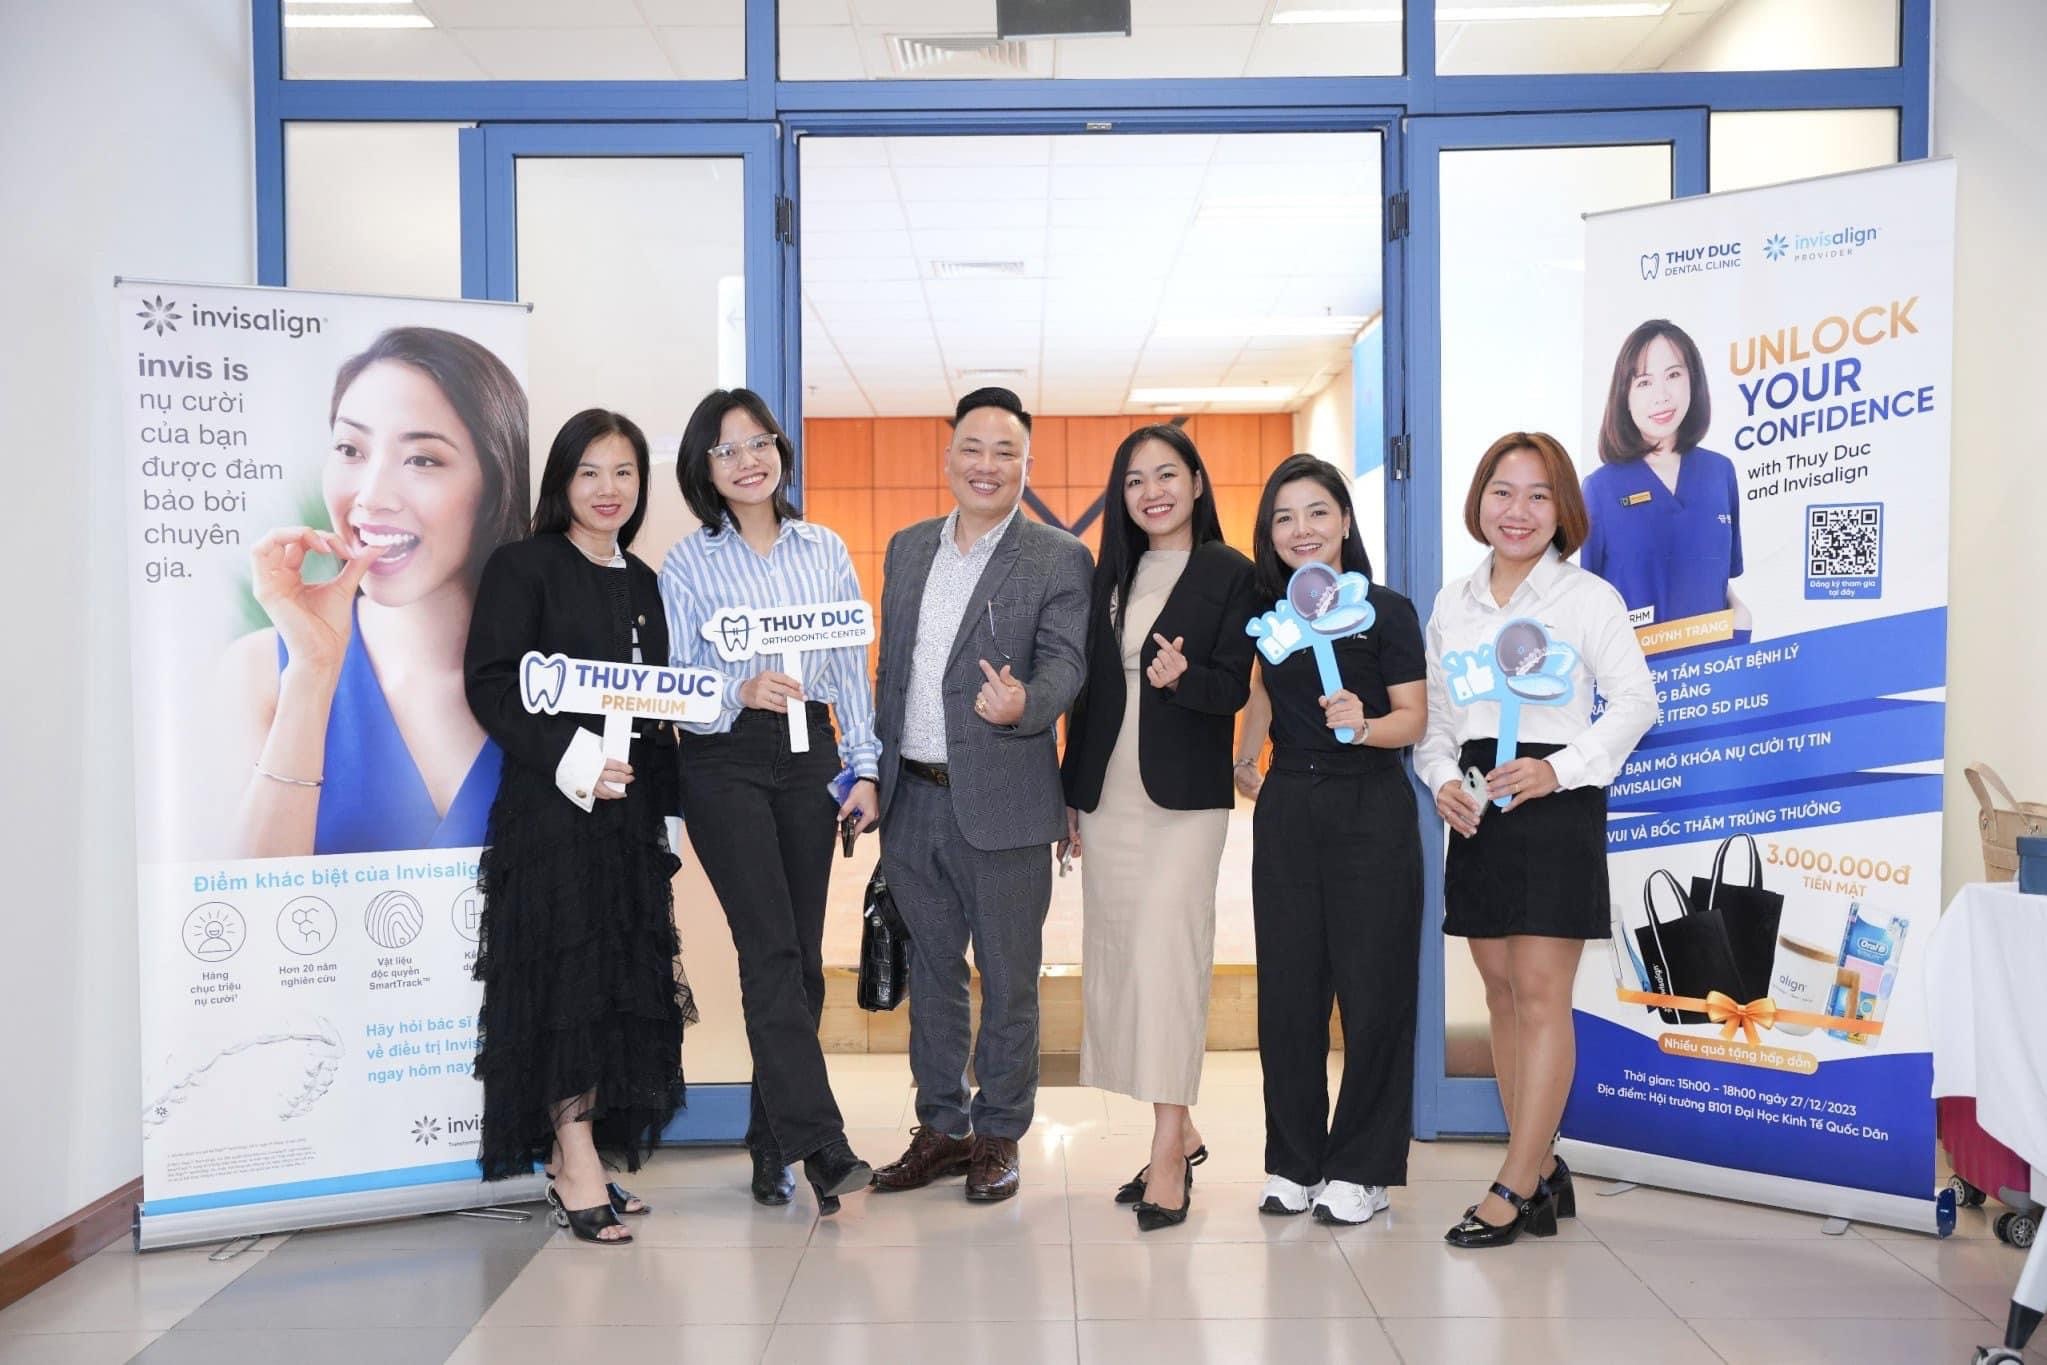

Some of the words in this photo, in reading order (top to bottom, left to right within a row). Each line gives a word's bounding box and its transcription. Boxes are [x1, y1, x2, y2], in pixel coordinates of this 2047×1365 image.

[1795, 227, 1878, 252] invisalign
[1666, 245, 1704, 264] THUY
[1708, 242, 1741, 258] DUC
[1794, 248, 1853, 262] PROVIDER
[1665, 263, 1703, 276] DENTAL
[1706, 258, 1741, 271] CLINIC
[192, 304, 321, 338] invisalign
[1729, 296, 1920, 376] UNLOCK
[138, 353, 212, 379] invis
[224, 353, 248, 381] is
[1738, 357, 1861, 417] YOUR
[140, 393, 172, 414] nụ
[183, 391, 243, 413] cười
[1734, 386, 1935, 451] CONFIDENCE
[141, 422, 189, 445] của
[200, 425, 247, 449] bạn
[142, 457, 216, 482] được
[226, 458, 283, 480] đảm
[1747, 459, 1781, 481] with
[1787, 452, 1828, 475] Thuy
[1834, 441, 1871, 458] Duc
[1747, 483, 1778, 501] and
[1784, 464, 1868, 493] Invisalign
[143, 490, 194, 511] bảo
[204, 490, 246, 511] bởi
[145, 523, 239, 550] chuyên
[146, 557, 192, 583] gia.
[1863, 580, 1875, 588] gia
[760, 613, 818, 632] THUY
[822, 609, 864, 625] DUC
[1630, 611, 1650, 622] RHM
[762, 632, 828, 645] ORTHODONTIC
[831, 628, 866, 639] CENTER
[1686, 621, 1728, 637] TRANG
[1704, 656, 1742, 674] SOÁT
[1747, 648, 1781, 668] BỆNH
[1785, 645, 1799, 660] LÝ
[576, 664, 651, 691] THUY
[656, 673, 716, 697] DUC
[602, 695, 686, 715] PREMIUM
[1668, 704, 1708, 722] ITERO
[1712, 701, 1731, 714] 5D
[1735, 694, 1768, 712] PLUS
[1626, 761, 1651, 776] BẠN
[1655, 753, 1678, 770] MỞ
[1681, 748, 1721, 766] KHÓA
[1726, 746, 1745, 761] NỤ
[1750, 737, 1783, 756] CƯỜI
[1787, 735, 1804, 752] TỰ
[1808, 732, 1831, 745] TIN
[1610, 776, 1682, 797] INVISALIGN
[1607, 830, 1627, 842] VUI
[1631, 824, 1647, 839] VÀ
[1651, 819, 1680, 837] BỐC
[1729, 806, 1776, 828] TRÚNG
[1780, 800, 1841, 821] THƯỞNG
[1766, 844, 1912, 885] 3.000.000đ
[194, 869, 248, 892] Điểm
[255, 868, 305, 888] khác
[312, 866, 349, 886] biệt
[355, 866, 390, 882] của
[397, 862, 479, 880] Invisalig
[1836, 879, 1866, 898] MẶT
[202, 972, 228, 981] Hàng
[279, 965, 299, 974] Hơn
[303, 964, 314, 972] 20
[190, 984, 216, 994] chục
[218, 982, 241, 992] triệu
[281, 976, 314, 987] nghiên
[1780, 975, 1805, 992] align
[195, 998, 207, 1006] nụ
[366, 1024, 394, 1038] Hãy
[400, 1020, 422, 1033] hỏi
[428, 1017, 453, 1031] bác
[459, 1016, 472, 1028] sĩ
[367, 1042, 384, 1059] về
[388, 1041, 420, 1056] điều
[425, 1041, 440, 1055] trị
[446, 1038, 481, 1051] Invis
[1701, 1041, 1725, 1058] quà
[1728, 1046, 1757, 1063] tặng
[368, 1070, 403, 1083] ngay
[409, 1064, 440, 1077] hôm
[1623, 1069, 1646, 1082] Thời
[1649, 1074, 1675, 1089] gian:
[1678, 1078, 1711, 1092] 15h00
[1722, 1084, 1756, 1100] 18h00
[1759, 1089, 1788, 1107] ngày
[1791, 1095, 1857, 1116] 27/12/2023
[1597, 1084, 1615, 1098] Địa
[1617, 1085, 1647, 1102] điểm:
[1649, 1092, 1667, 1107] Hội
[1669, 1093, 1705, 1113] trường
[1708, 1102, 1732, 1114] B101
[1734, 1105, 1754, 1119] Đại
[1757, 1108, 1780, 1124] Học
[1782, 1111, 1807, 1127] Kinh
[1810, 1113, 1823, 1130] Tế
[1826, 1118, 1859, 1136] Quốc
[1862, 1124, 1889, 1141] Dân
